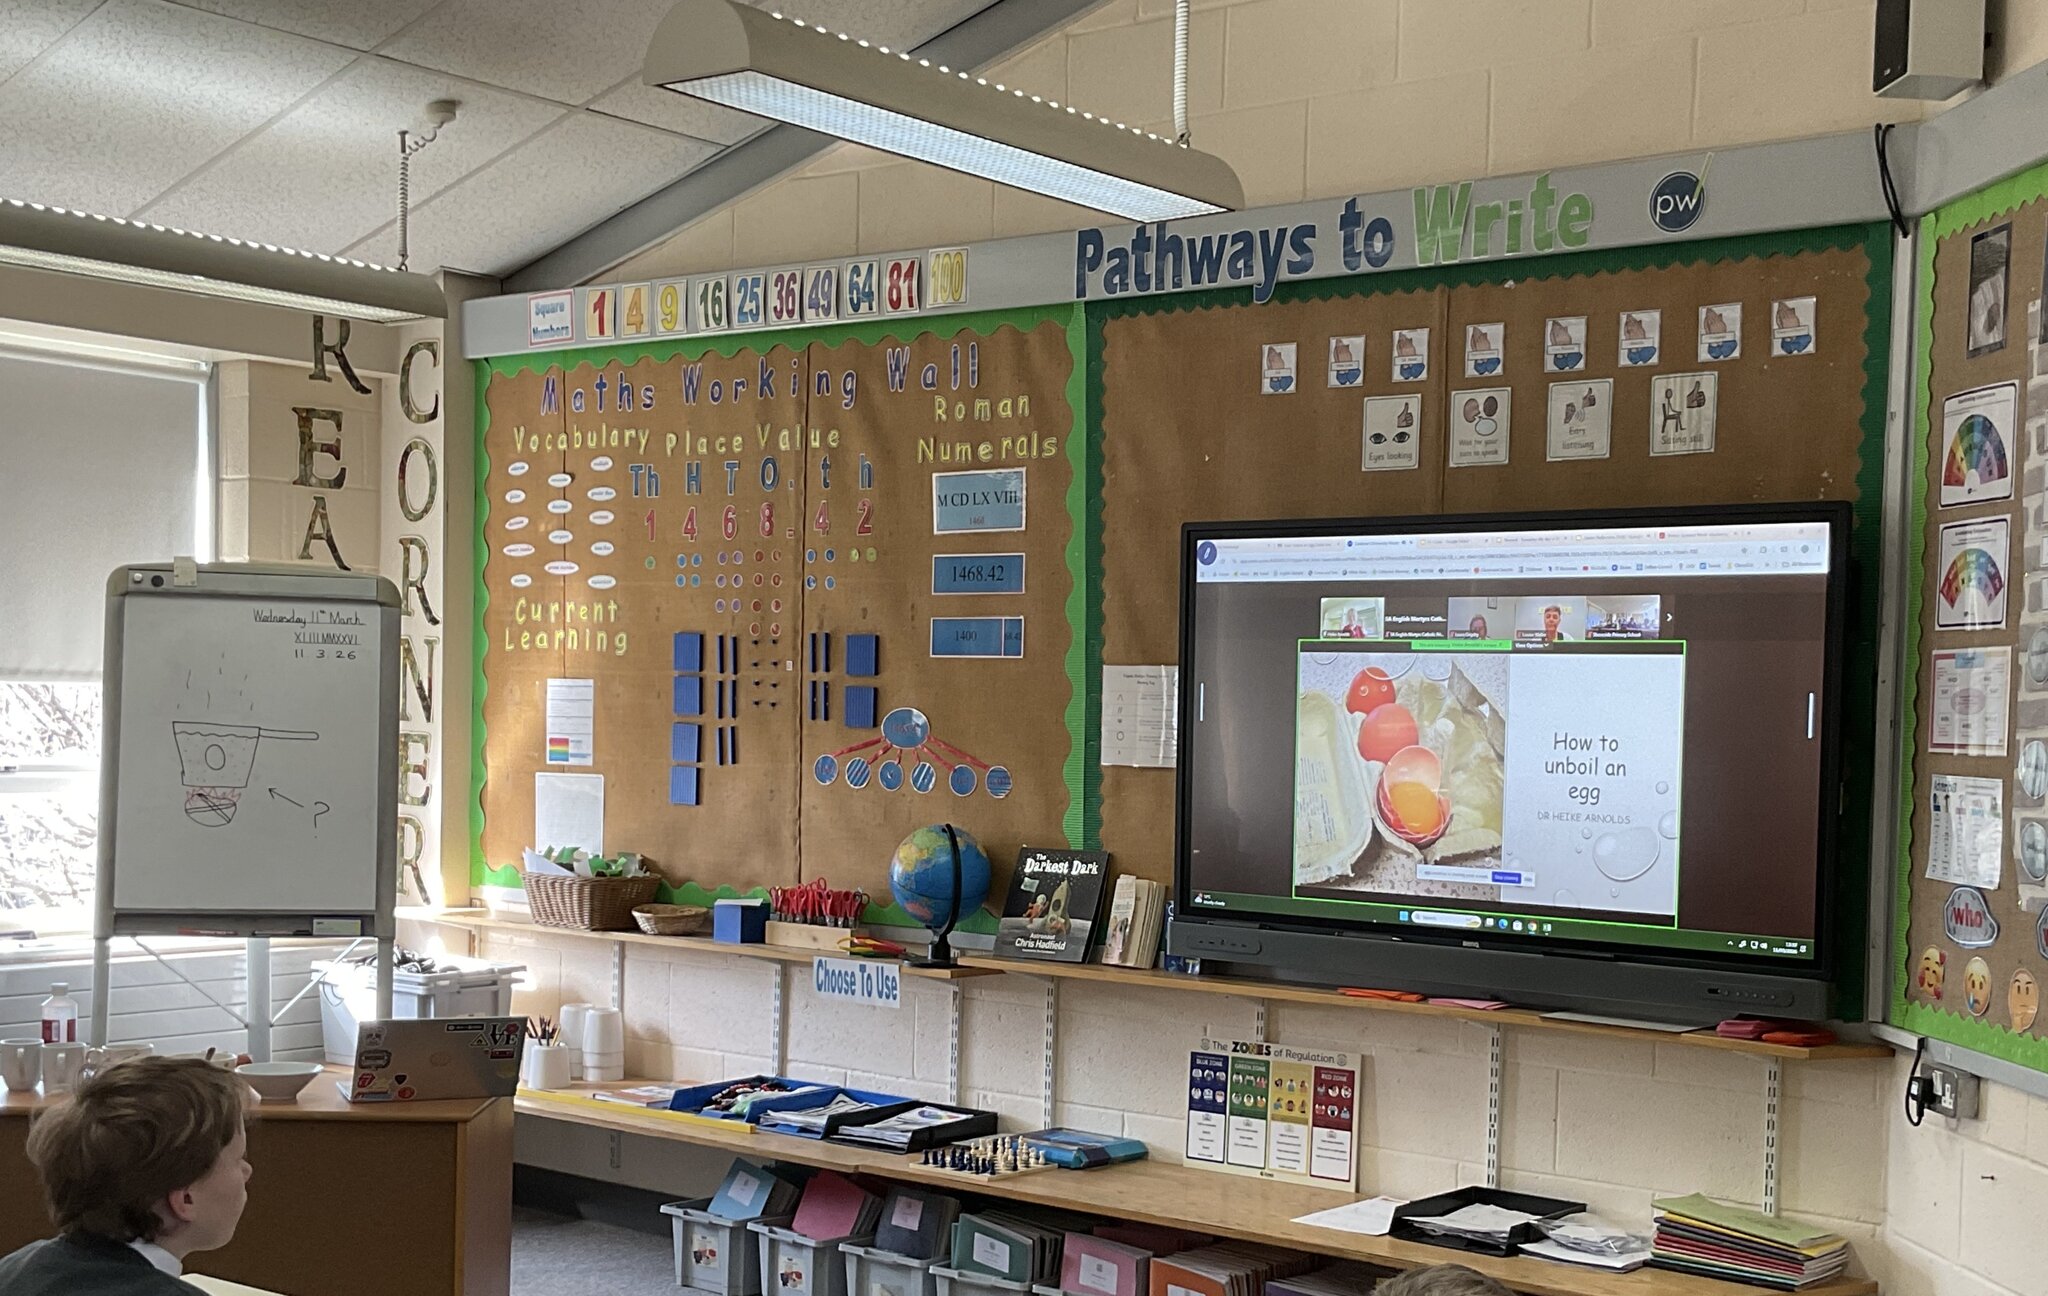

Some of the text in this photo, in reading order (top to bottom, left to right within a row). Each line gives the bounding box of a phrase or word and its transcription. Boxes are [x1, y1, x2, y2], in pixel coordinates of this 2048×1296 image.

[1657, 191, 1698, 218] pw
[1075, 171, 1594, 303] Pathways to Write
[592, 252, 964, 337] 1 4 9 16 25 36 49 64 81 100
[534, 302, 565, 318] Square
[540, 341, 979, 416] Maths Working Wall
[934, 395, 1030, 421] Roman
[513, 424, 650, 455] Vocabulary
[756, 423, 840, 451] Value
[917, 431, 1058, 464] Numerals
[1387, 451, 1413, 462] looking
[629, 463, 660, 498] Th
[685, 460, 701, 495] H
[724, 459, 740, 496] T
[859, 453, 873, 490] h
[938, 494, 948, 508] M
[951, 492, 970, 507] CD
[973, 491, 990, 506] LX
[645, 508, 656, 542] 1
[682, 506, 698, 542] 4
[722, 504, 737, 541] 6
[813, 500, 830, 536] 4
[857, 498, 872, 536] 2
[952, 564, 1005, 583] 1468.42
[253, 608, 307, 629] Wednesday
[329, 610, 361, 625] March
[515, 597, 618, 625] Current
[397, 341, 441, 906] CORNER
[505, 627, 627, 656] Learning
[954, 630, 977, 642] 1400
[295, 648, 357, 660] 11 3 26
[1553, 732, 1619, 752] How to
[1545, 756, 1626, 776] unboil an
[1568, 786, 1601, 806] egg
[1537, 811, 1631, 825] DR HEIKE ARNOLDS
[1024, 858, 1099, 876] Darkest Dark
[1036, 853, 1047, 861] The
[1952, 902, 1984, 928] who
[1015, 937, 1067, 951] Chris Hadfield
[1030, 933, 1055, 941] Astronaut
[815, 965, 898, 1001] Choose To Use
[1212, 1040, 1335, 1064] The ZONES of Regulation
